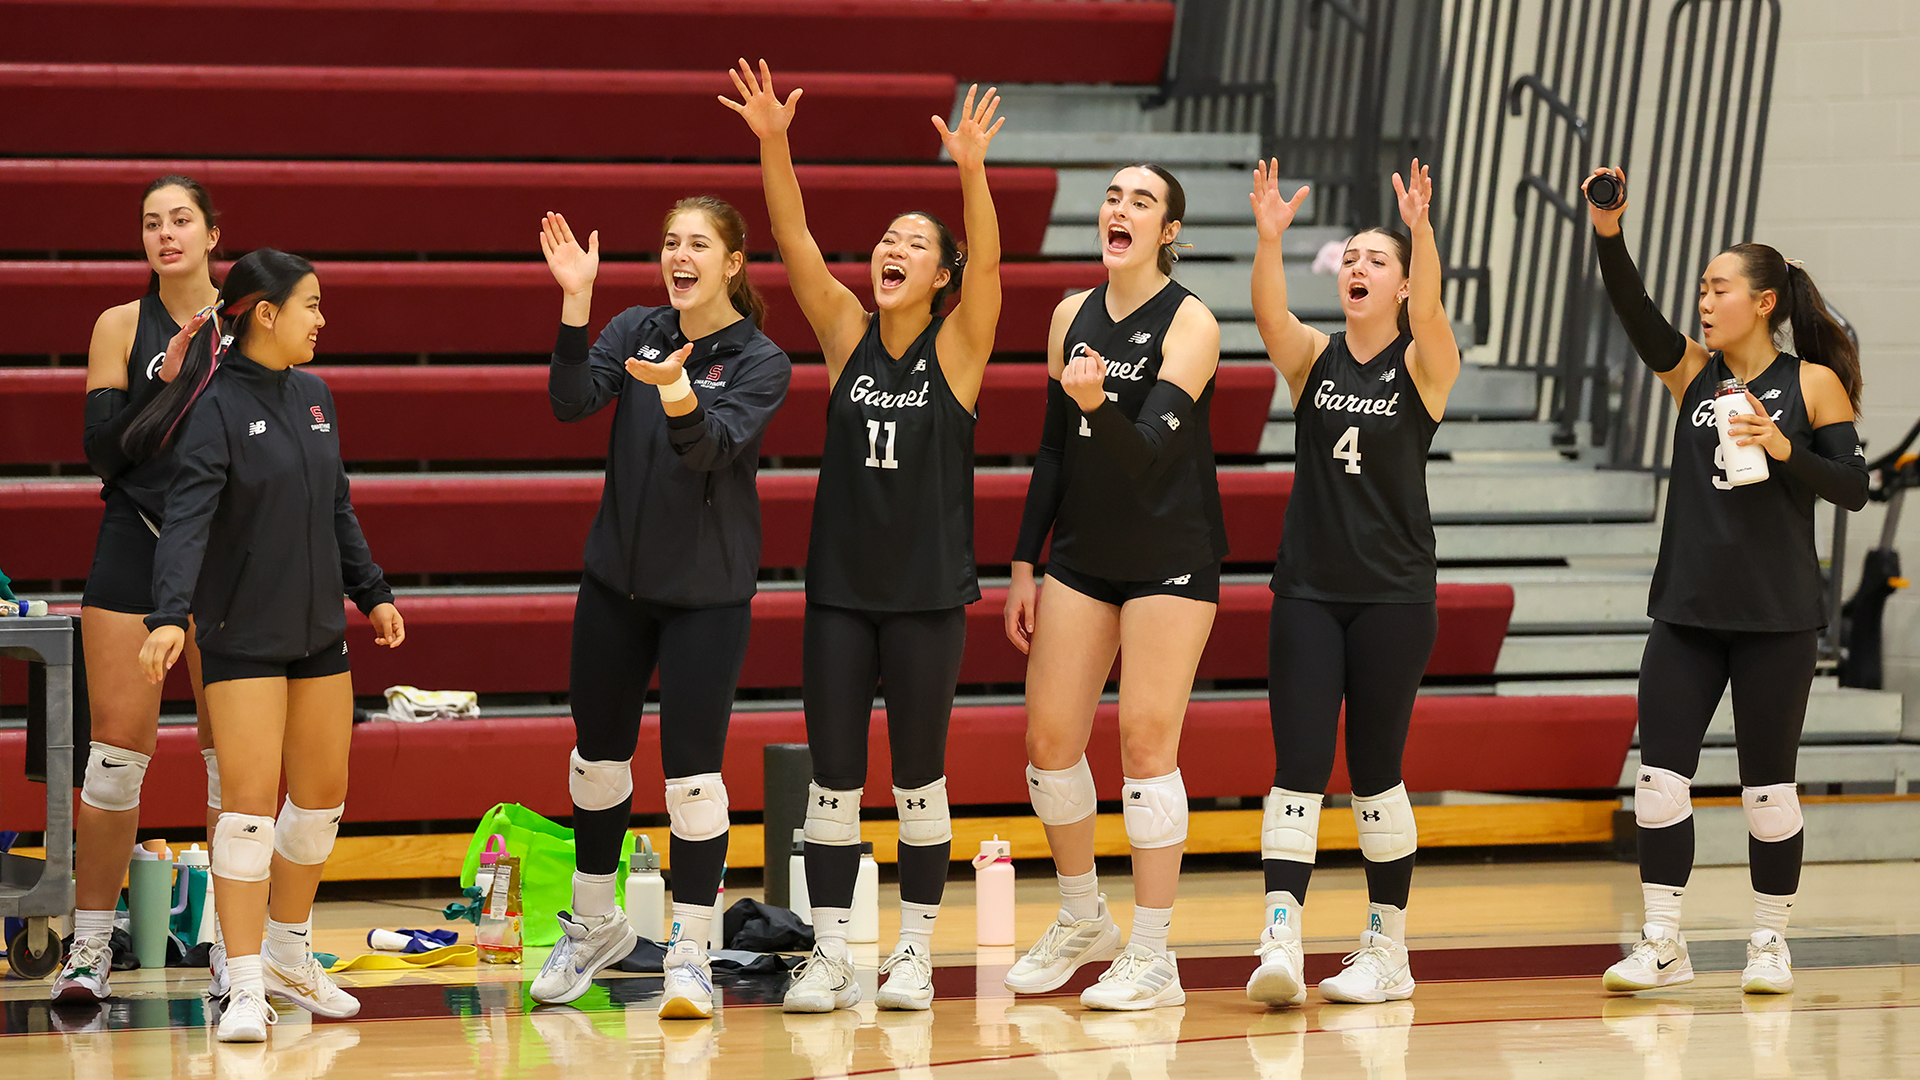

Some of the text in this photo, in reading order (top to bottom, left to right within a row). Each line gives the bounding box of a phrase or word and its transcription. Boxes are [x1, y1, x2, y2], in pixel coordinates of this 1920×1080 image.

[706, 364, 724, 381] S
[1069, 342, 1148, 381] rnet
[850, 374, 929, 408] Garnet
[1314, 380, 1400, 416] Garnet
[865, 419, 899, 469] 11
[1332, 426, 1362, 475] 4
